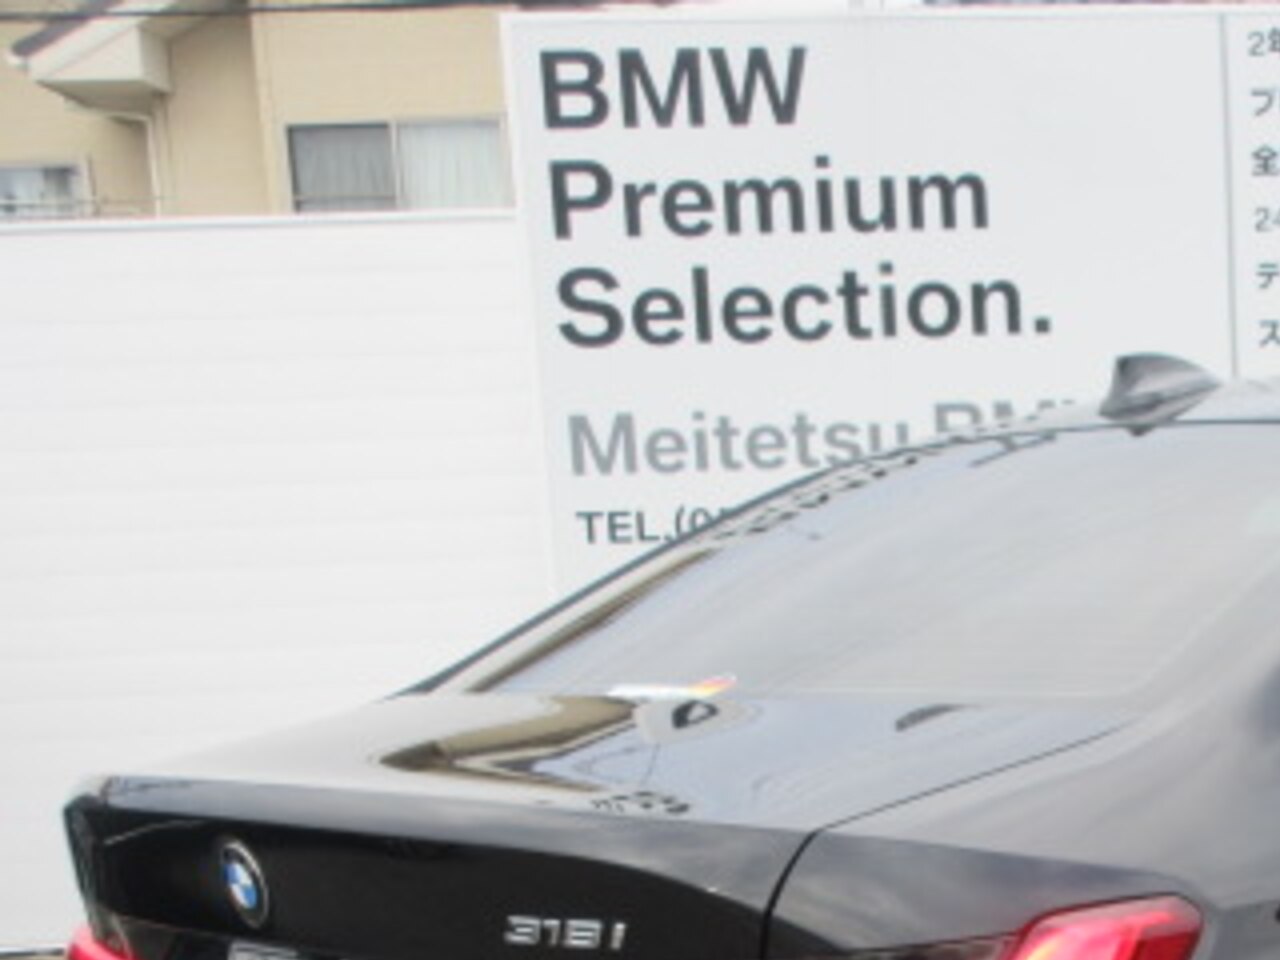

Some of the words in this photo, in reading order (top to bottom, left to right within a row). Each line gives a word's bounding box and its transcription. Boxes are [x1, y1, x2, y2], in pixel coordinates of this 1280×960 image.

[539, 46, 807, 130] BMW
[548, 155, 990, 240] Premium
[557, 262, 1051, 348] Selection.
